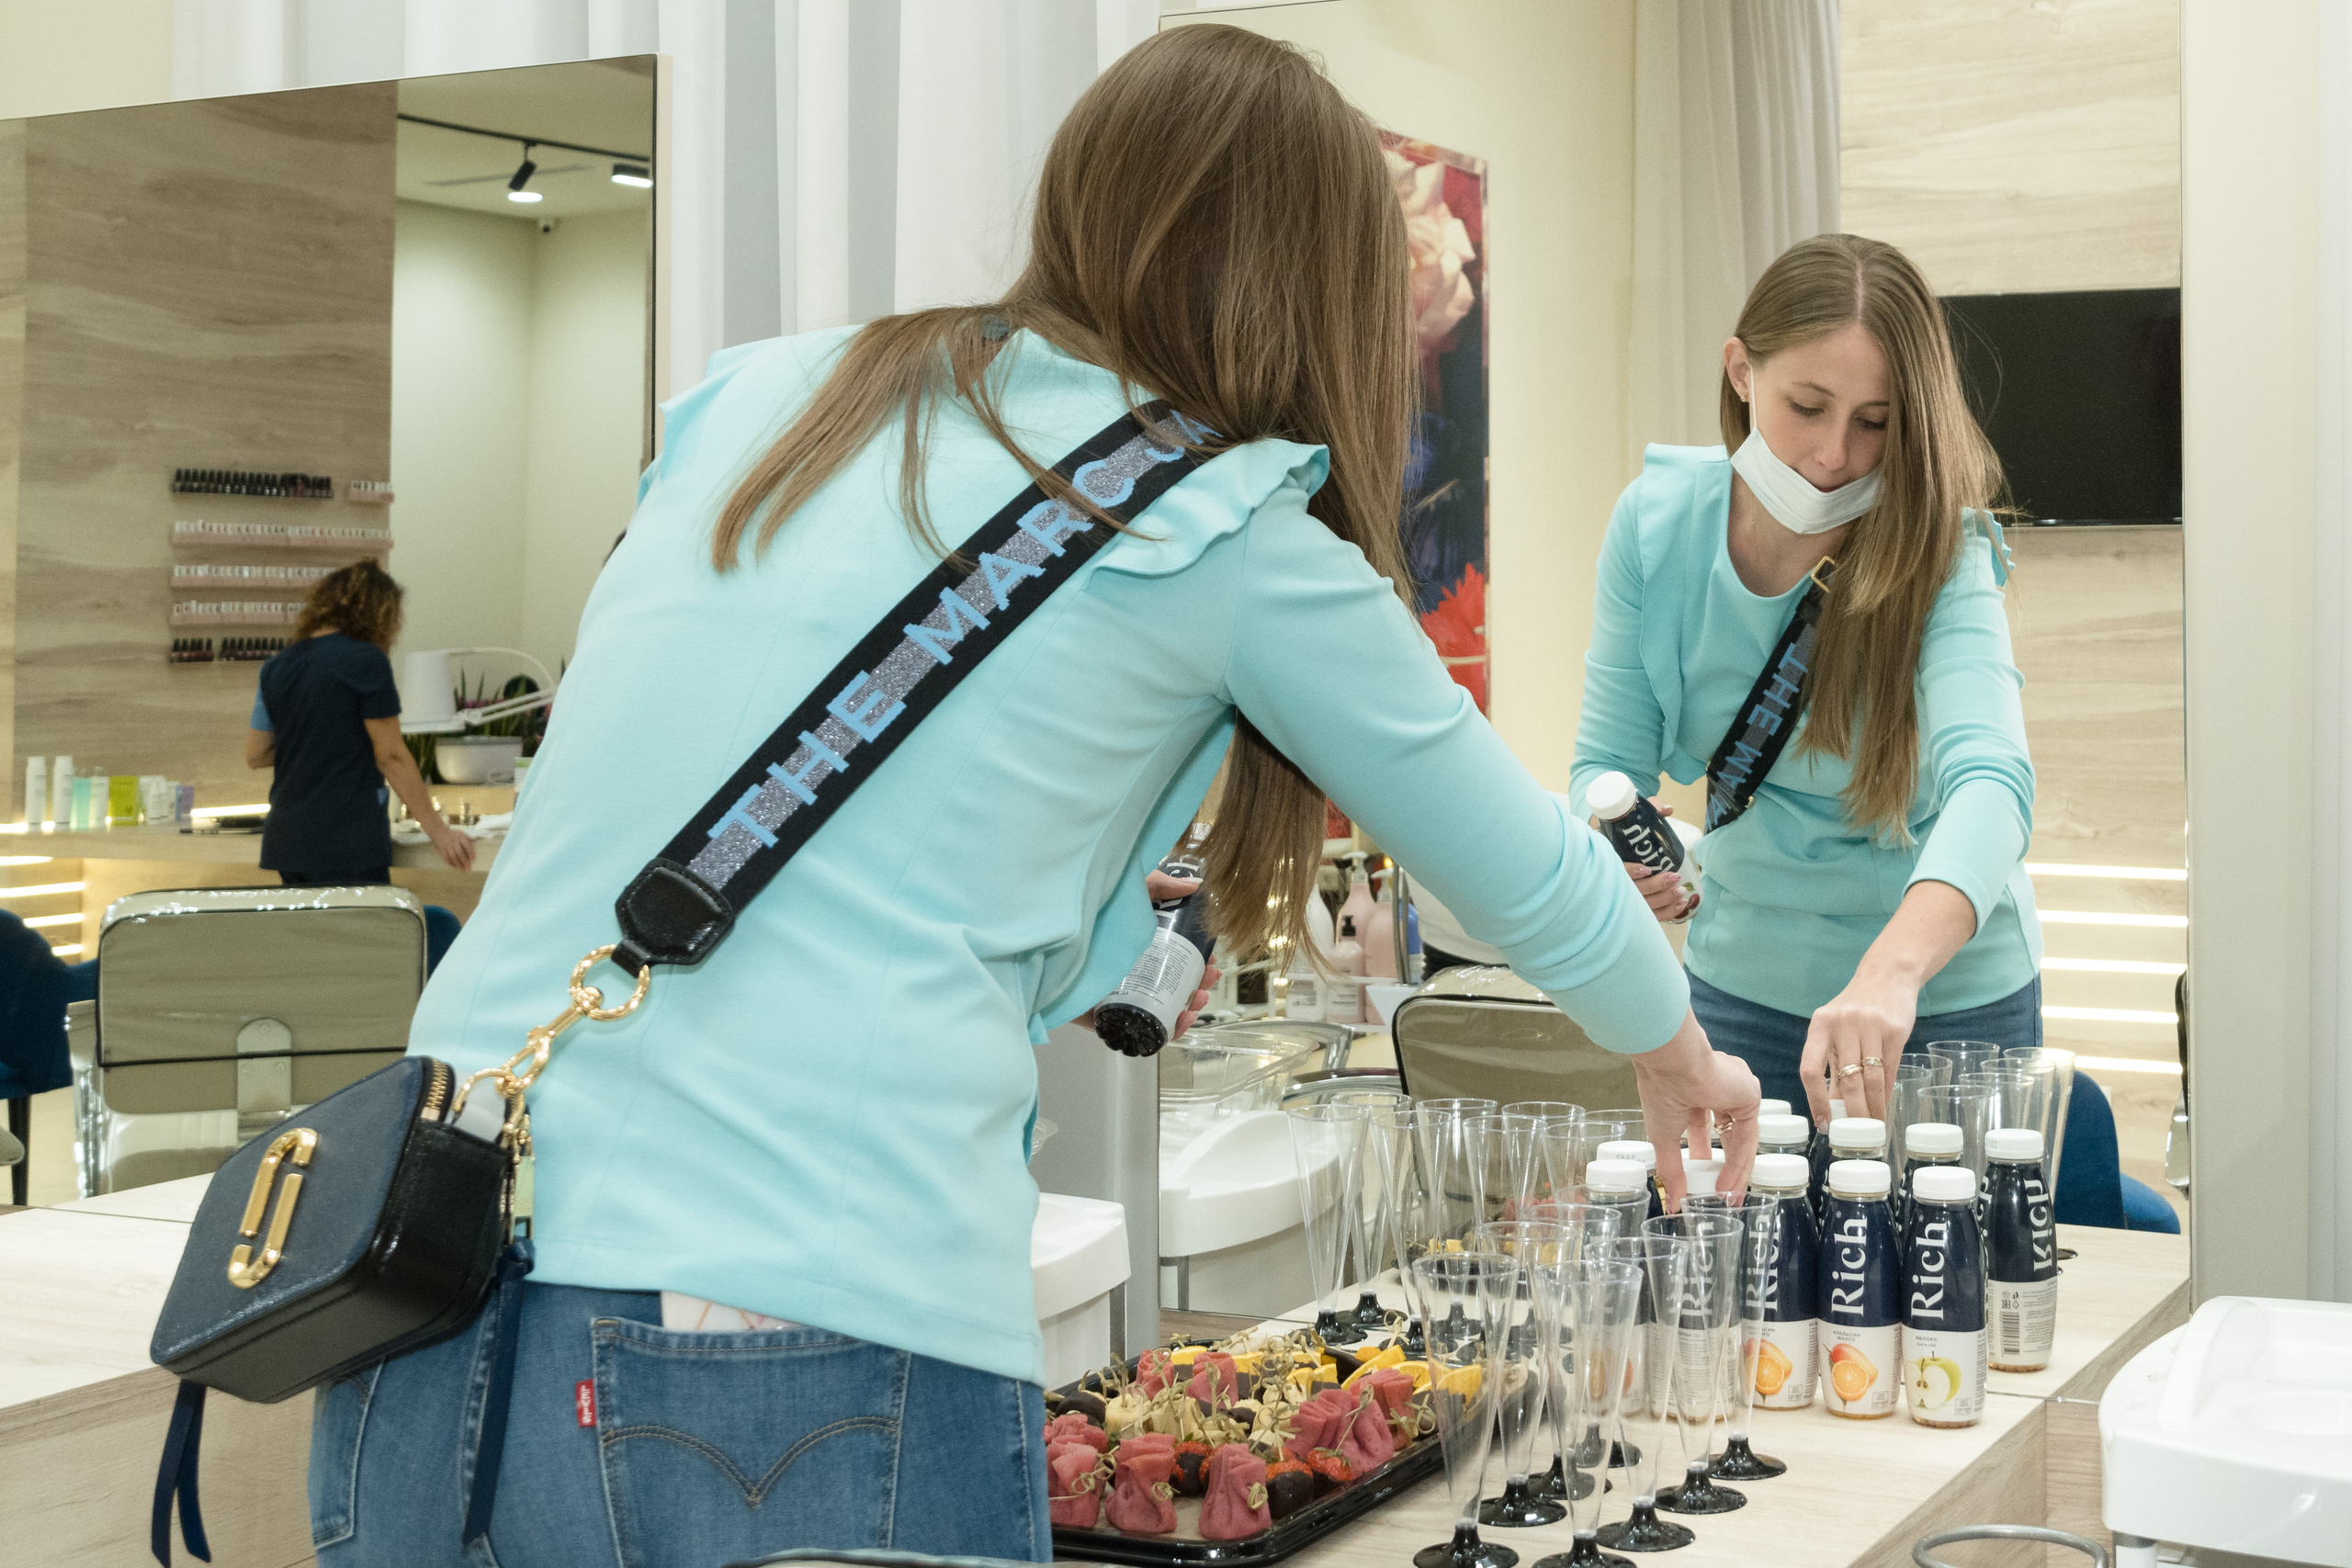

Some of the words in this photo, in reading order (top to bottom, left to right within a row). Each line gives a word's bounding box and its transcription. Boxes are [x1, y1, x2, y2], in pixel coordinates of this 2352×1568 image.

[707, 670, 907, 849] THE
[1746, 1214, 1781, 1312] Rich
[1830, 1217, 1868, 1317] Rich
[1911, 1222, 1948, 1321] Rich
